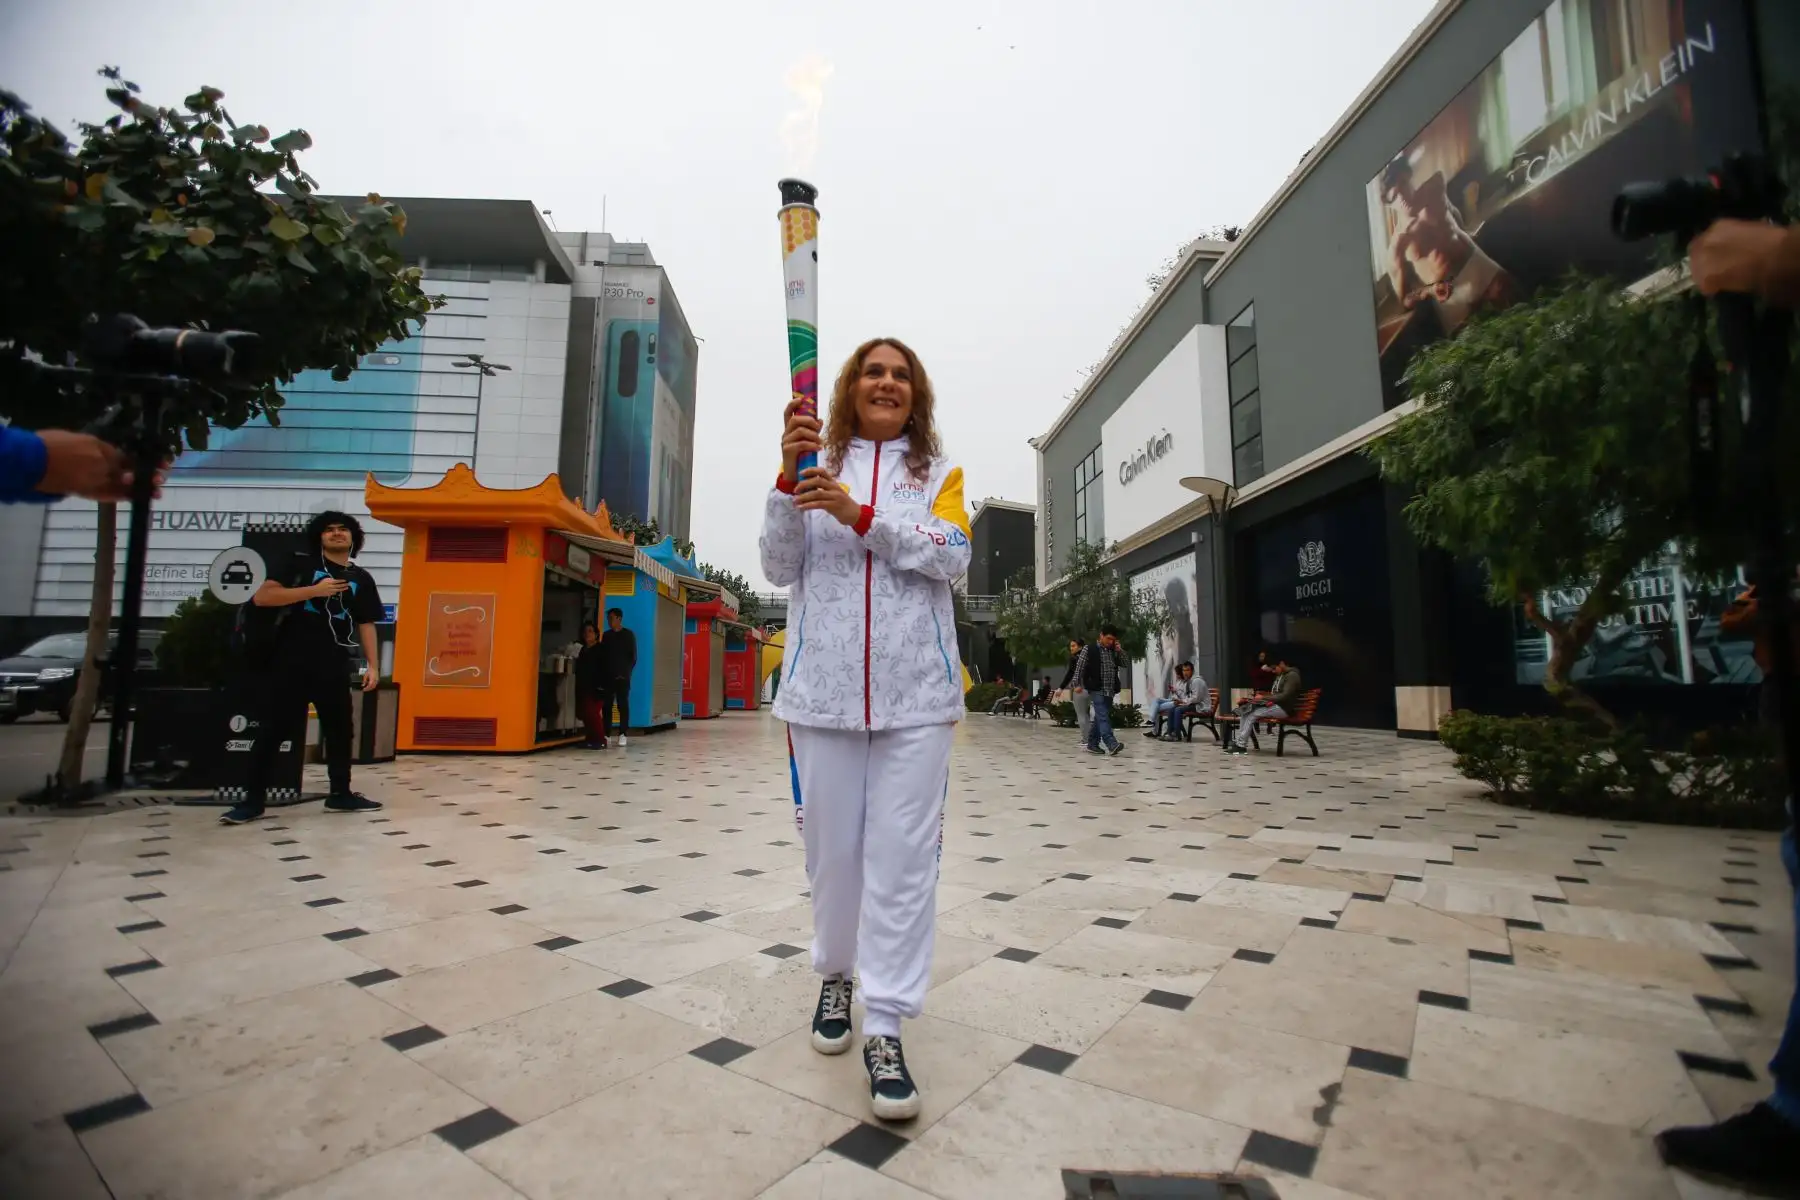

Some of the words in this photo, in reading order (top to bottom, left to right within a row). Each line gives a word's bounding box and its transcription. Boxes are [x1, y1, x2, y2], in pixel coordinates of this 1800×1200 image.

[1526, 99, 1617, 184] CALVIN
[1623, 21, 1714, 113] KLEIN
[604, 288, 624, 298] P30
[627, 289, 644, 298] Pro
[1295, 578, 1331, 600] BOGGI
